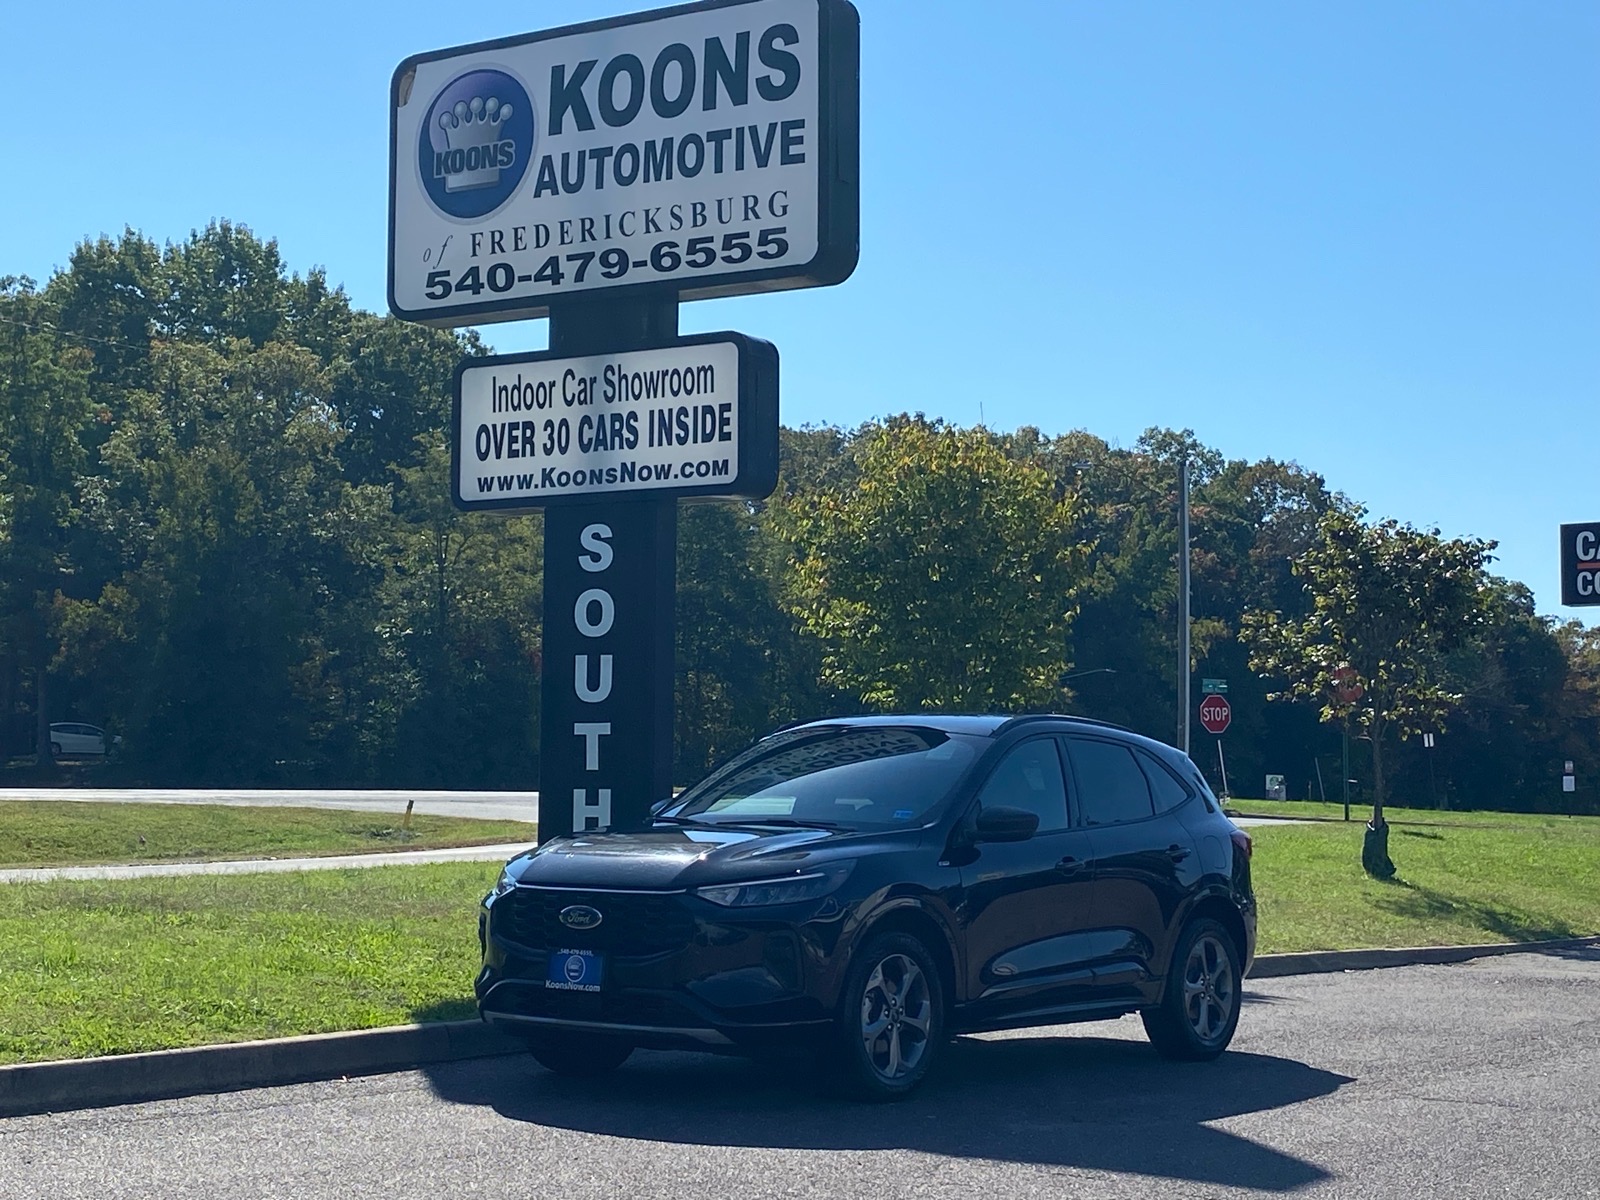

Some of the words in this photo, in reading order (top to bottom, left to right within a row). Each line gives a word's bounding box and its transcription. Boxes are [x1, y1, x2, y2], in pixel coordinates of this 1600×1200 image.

[548, 23, 801, 136] KOONS
[435, 141, 514, 176] KOONS
[533, 118, 806, 198] AUTOMOTIVE
[423, 235, 453, 269] of
[470, 190, 790, 258] FREDERICKSBURG
[425, 227, 790, 300] 540-479-6555
[492, 374, 556, 413] Indoor
[562, 368, 597, 406] Car
[603, 363, 715, 404] Showroom
[475, 420, 536, 461] OVER
[542, 418, 570, 455] 30
[578, 410, 639, 453] CARS
[649, 402, 732, 448] INSIDE
[1576, 530, 1600, 562] C
[573, 523, 615, 833] SOUTH
[1203, 707, 1228, 721] STOP
[567, 910, 592, 923] Ford
[545, 979, 600, 992] KoonsNow.com
